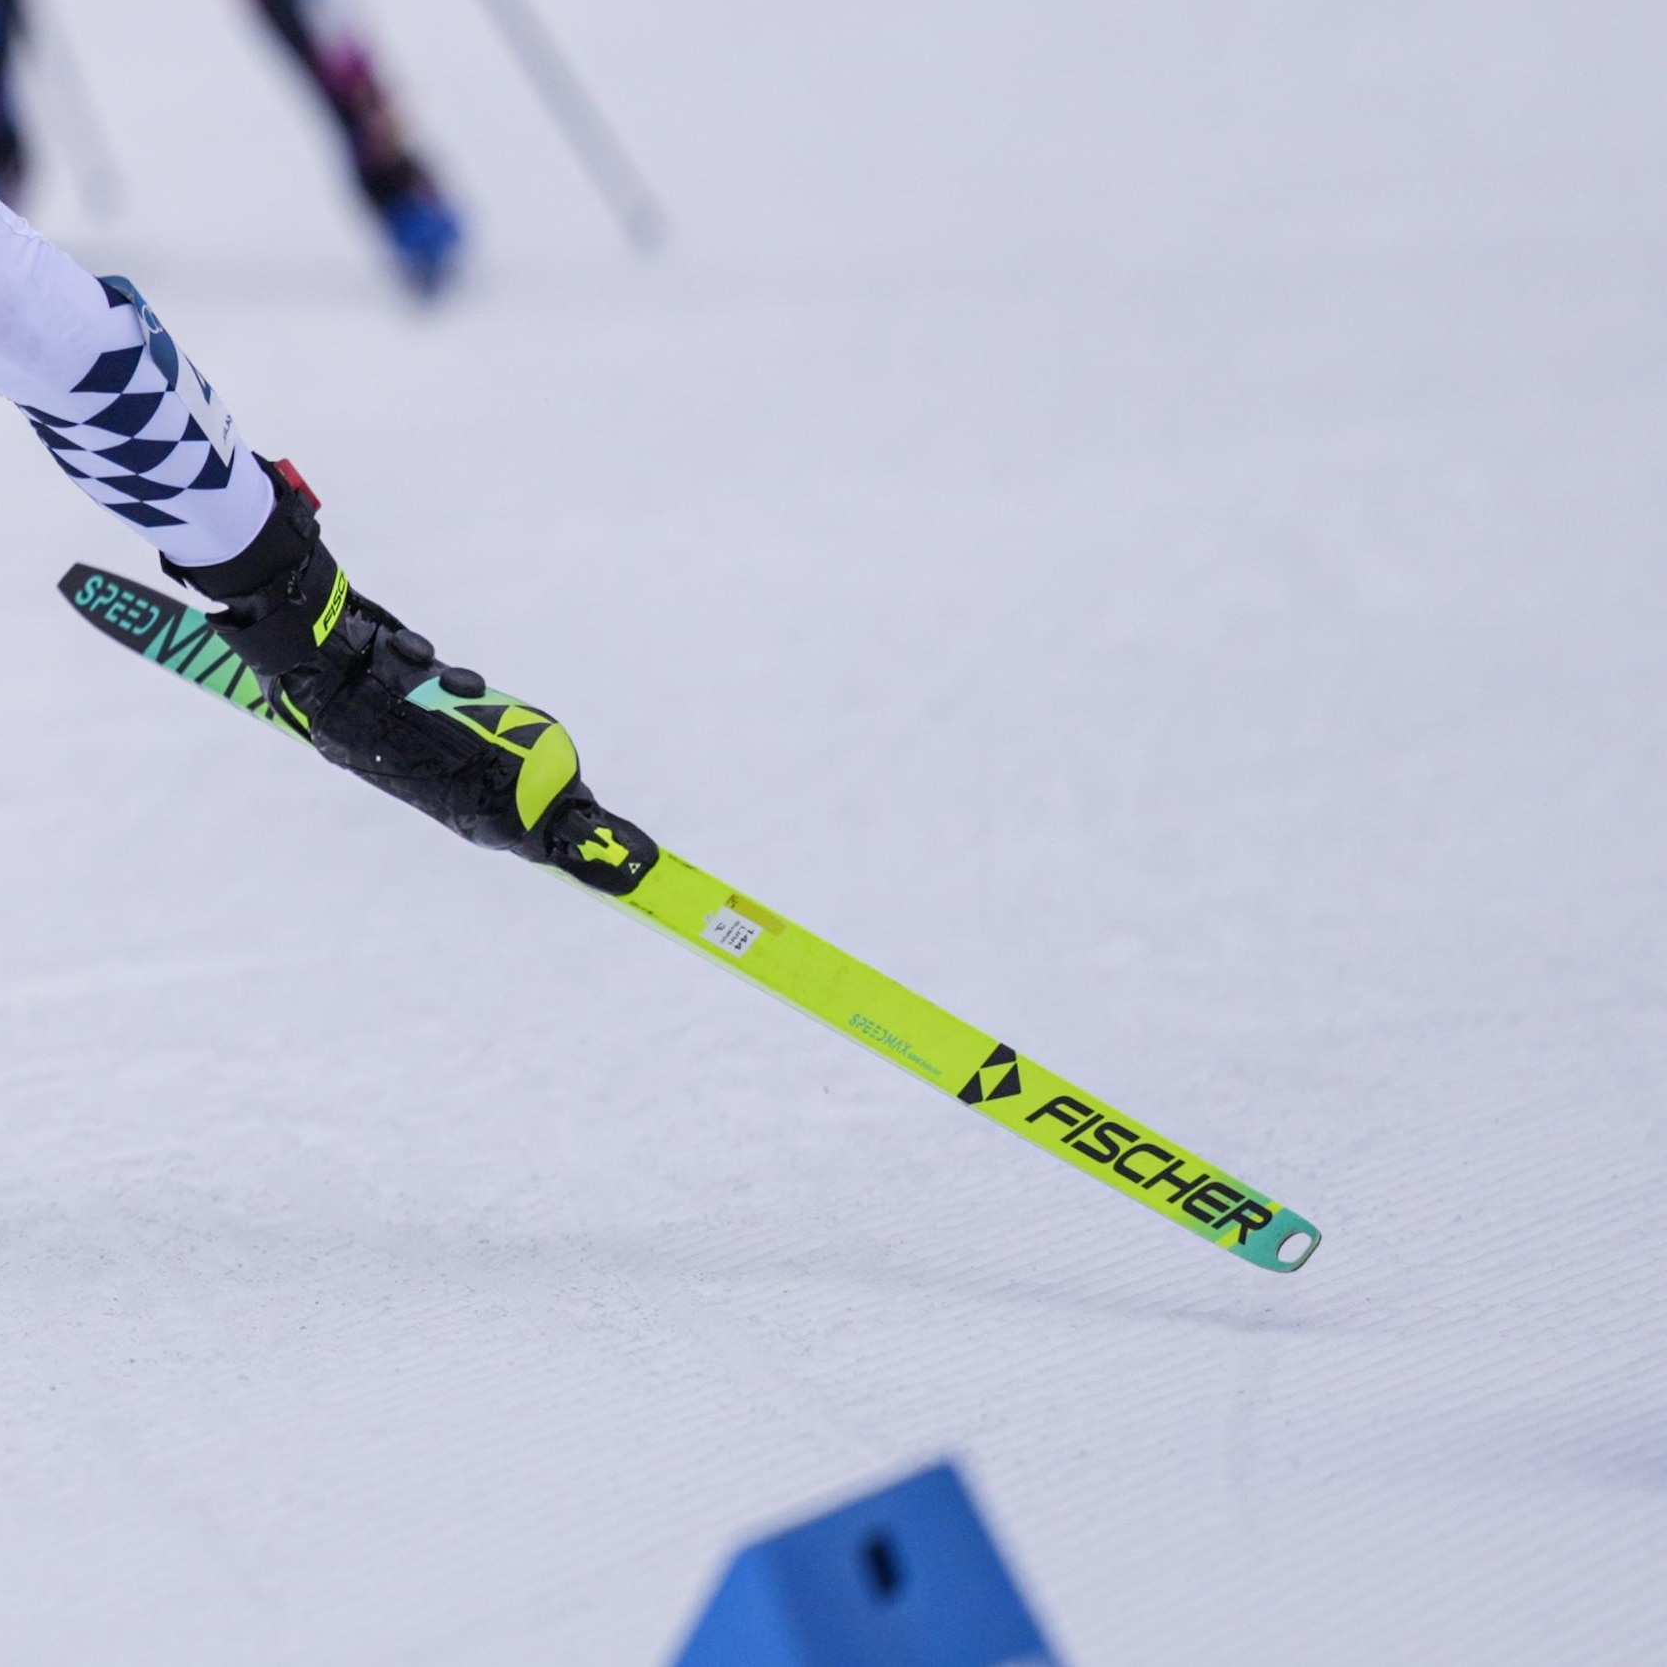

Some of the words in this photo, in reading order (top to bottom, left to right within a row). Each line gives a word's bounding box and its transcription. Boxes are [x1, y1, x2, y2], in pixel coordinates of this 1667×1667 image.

[734, 929, 755, 950] 144
[849, 1013, 912, 1056] SPEEDMAX
[1025, 1095, 1273, 1245] FISCHER
